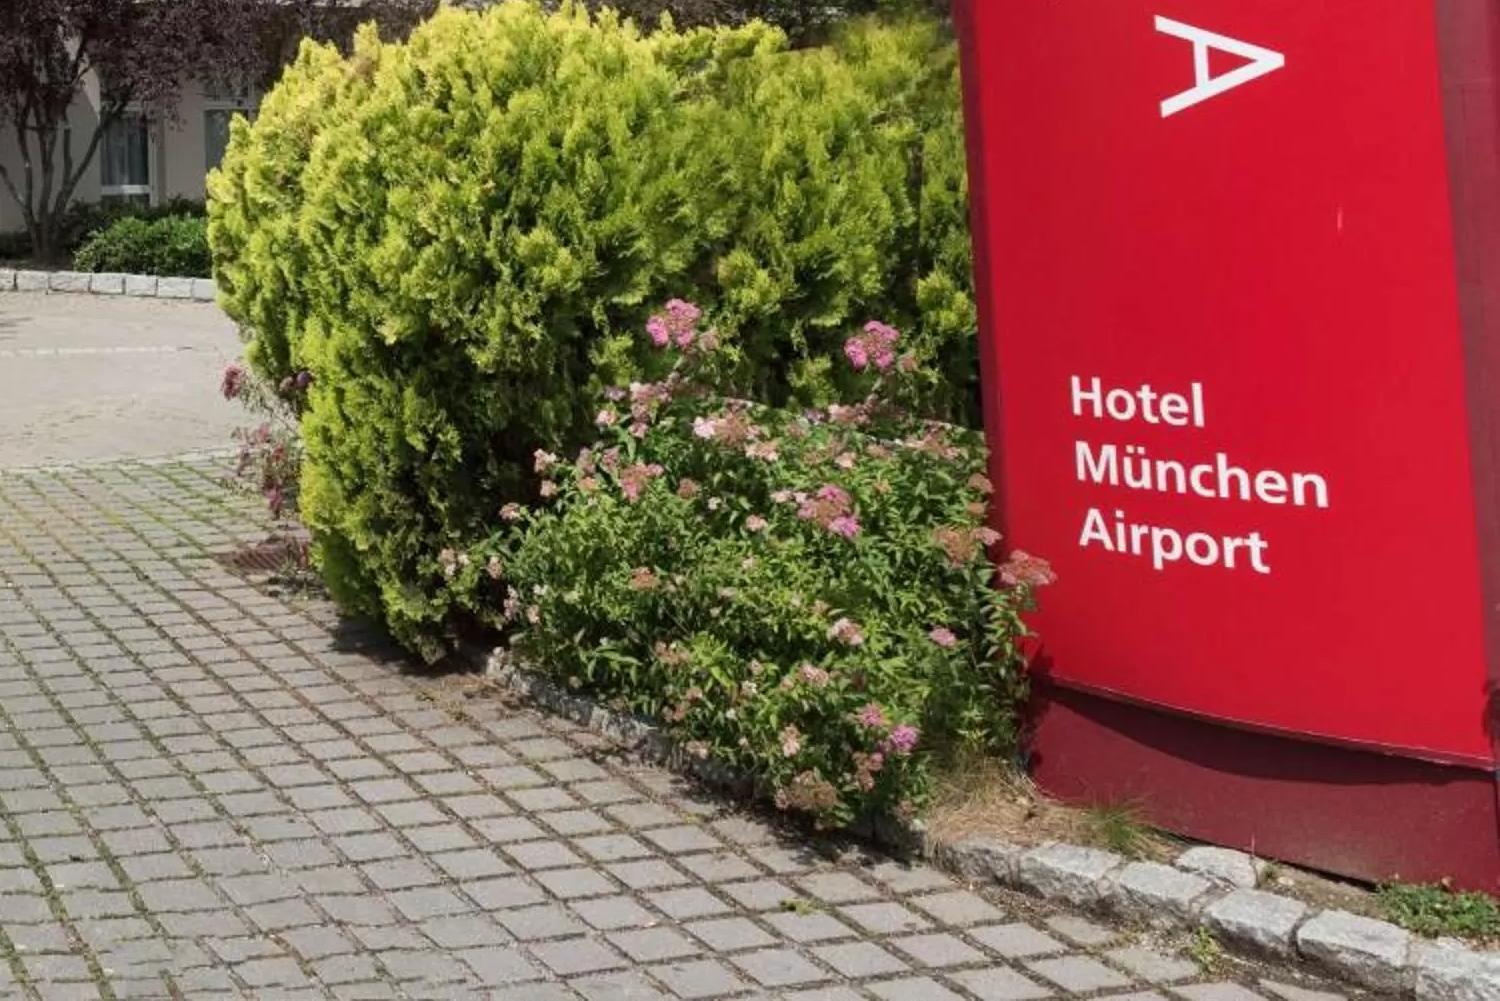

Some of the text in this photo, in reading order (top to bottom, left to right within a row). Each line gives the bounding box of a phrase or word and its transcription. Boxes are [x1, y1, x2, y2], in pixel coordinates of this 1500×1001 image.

[1070, 374, 1206, 428] Hotel
[1074, 439, 1330, 509] München
[1078, 506, 1271, 575] Airport
